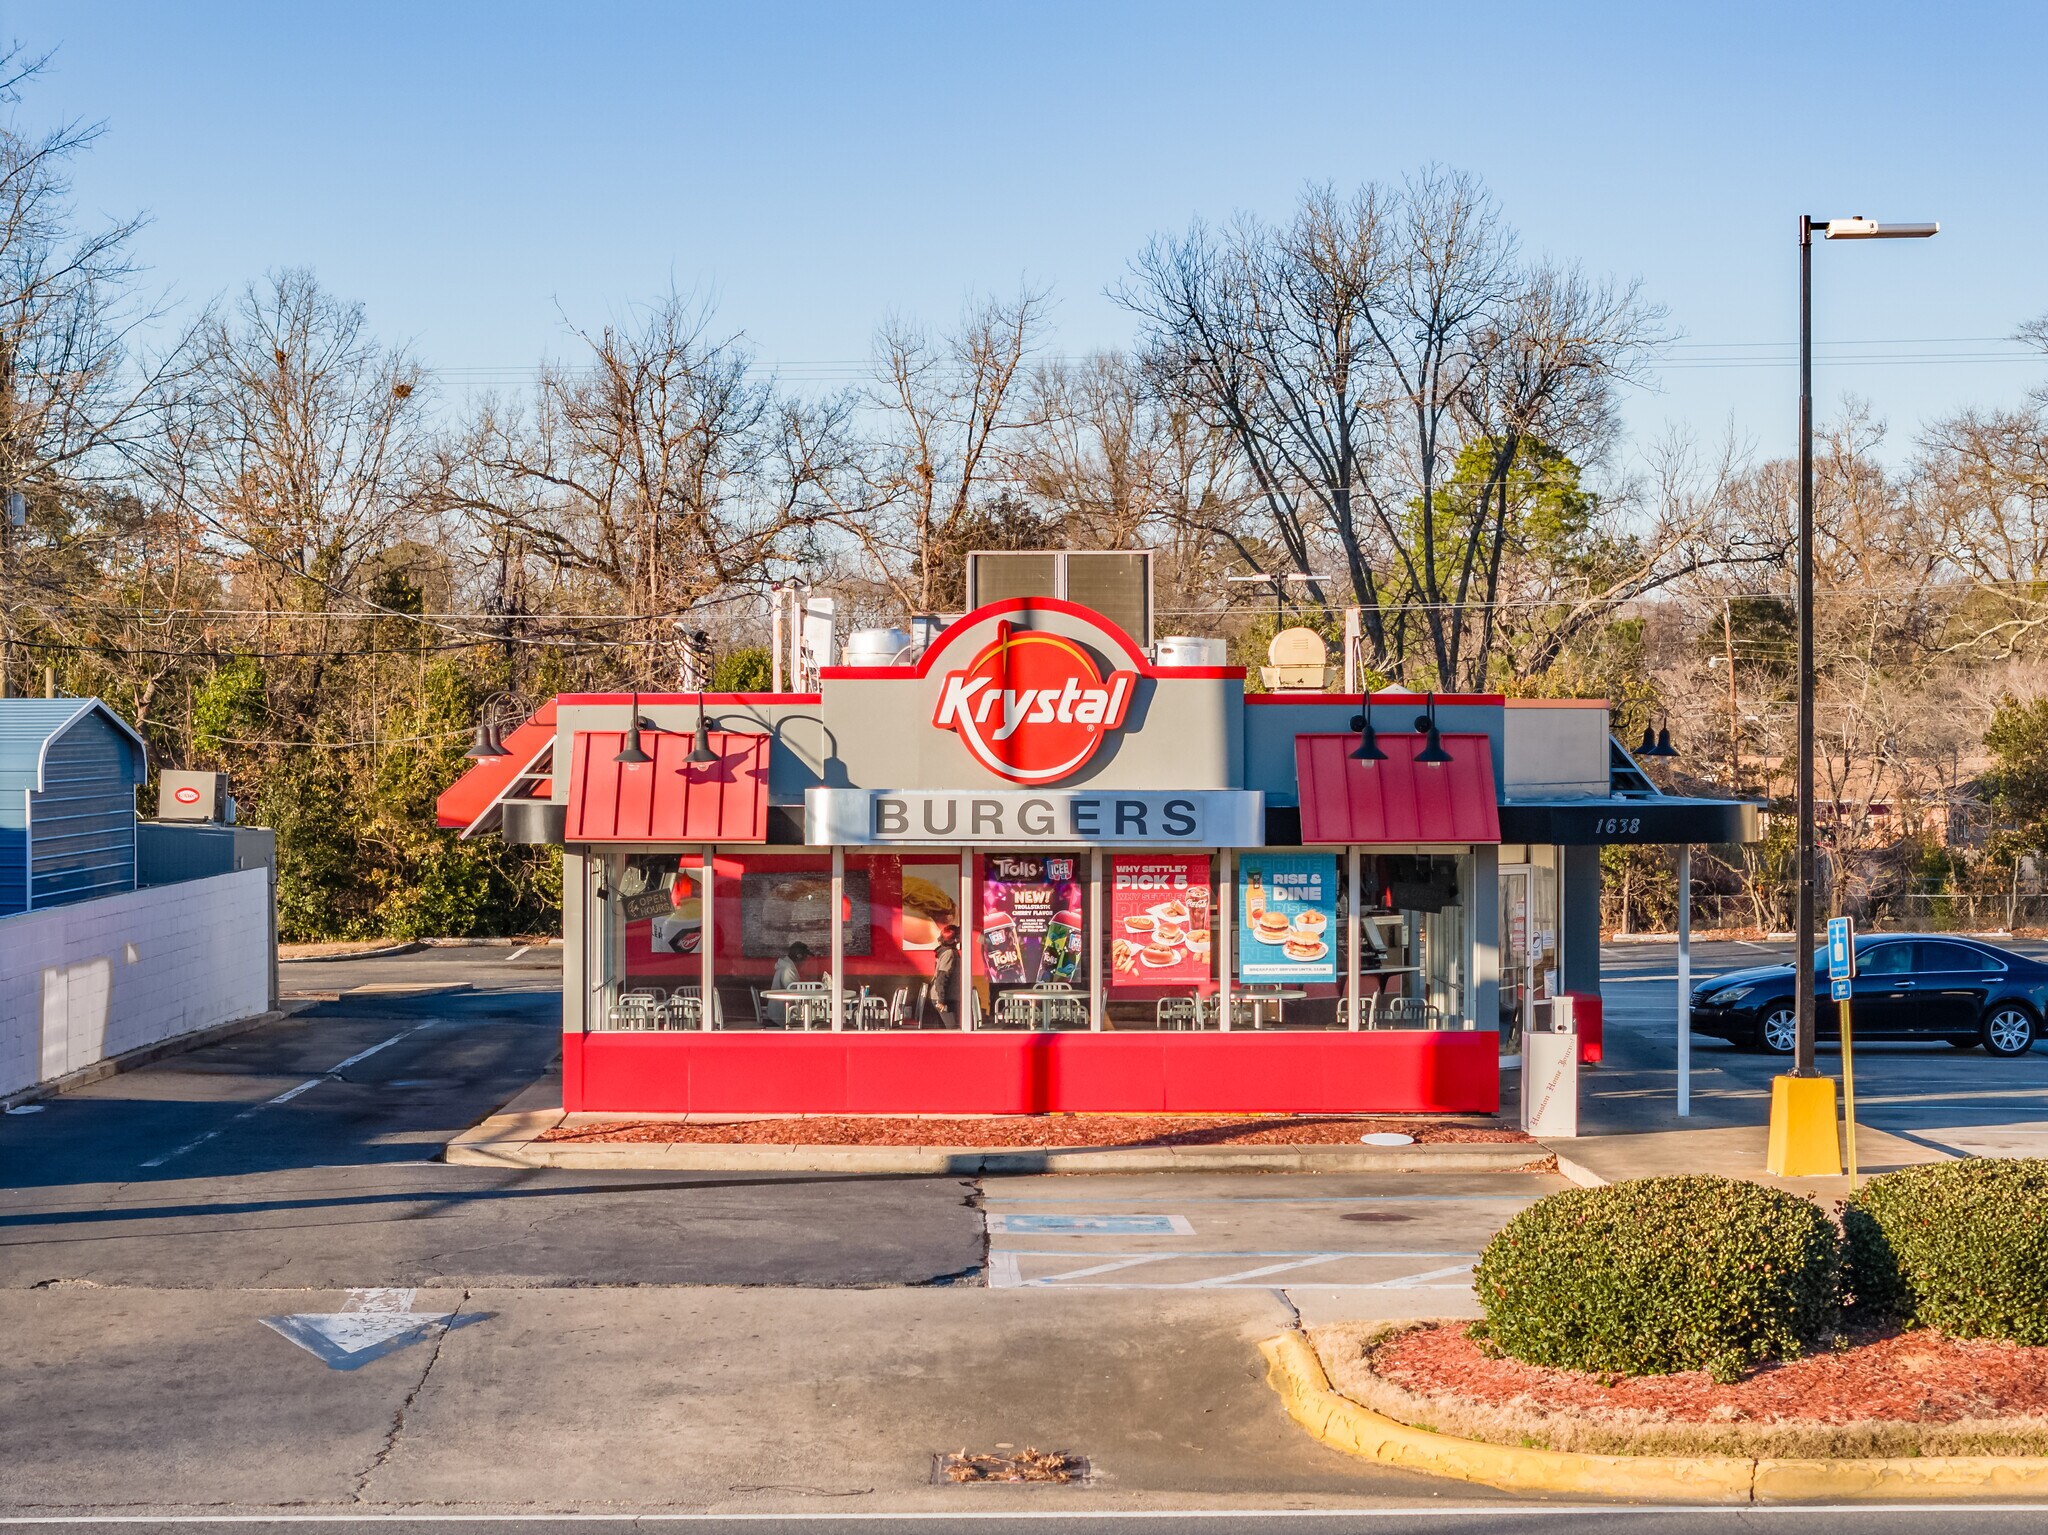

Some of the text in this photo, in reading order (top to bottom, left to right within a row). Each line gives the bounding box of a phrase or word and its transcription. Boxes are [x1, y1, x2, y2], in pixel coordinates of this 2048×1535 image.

[938, 677, 1128, 741] Krystal
[876, 799, 1197, 835] BURGERS
[1595, 818, 1640, 834] 1638
[993, 858, 1037, 877] Trolls
[1050, 863, 1069, 875] ICEE
[1116, 865, 1140, 873] WHY
[1141, 865, 1188, 873] SETTLE?
[1116, 874, 1188, 890] PICK 5
[1273, 873, 1322, 884] RISE &
[639, 892, 667, 906] OPEN
[1014, 891, 1051, 903] NEW!
[1273, 886, 1322, 900] DINE
[640, 902, 670, 917] HOURS
[988, 950, 1018, 967] Trolls
[1530, 1095, 1551, 1127] Houston
[1546, 1069, 1563, 1093] Home
